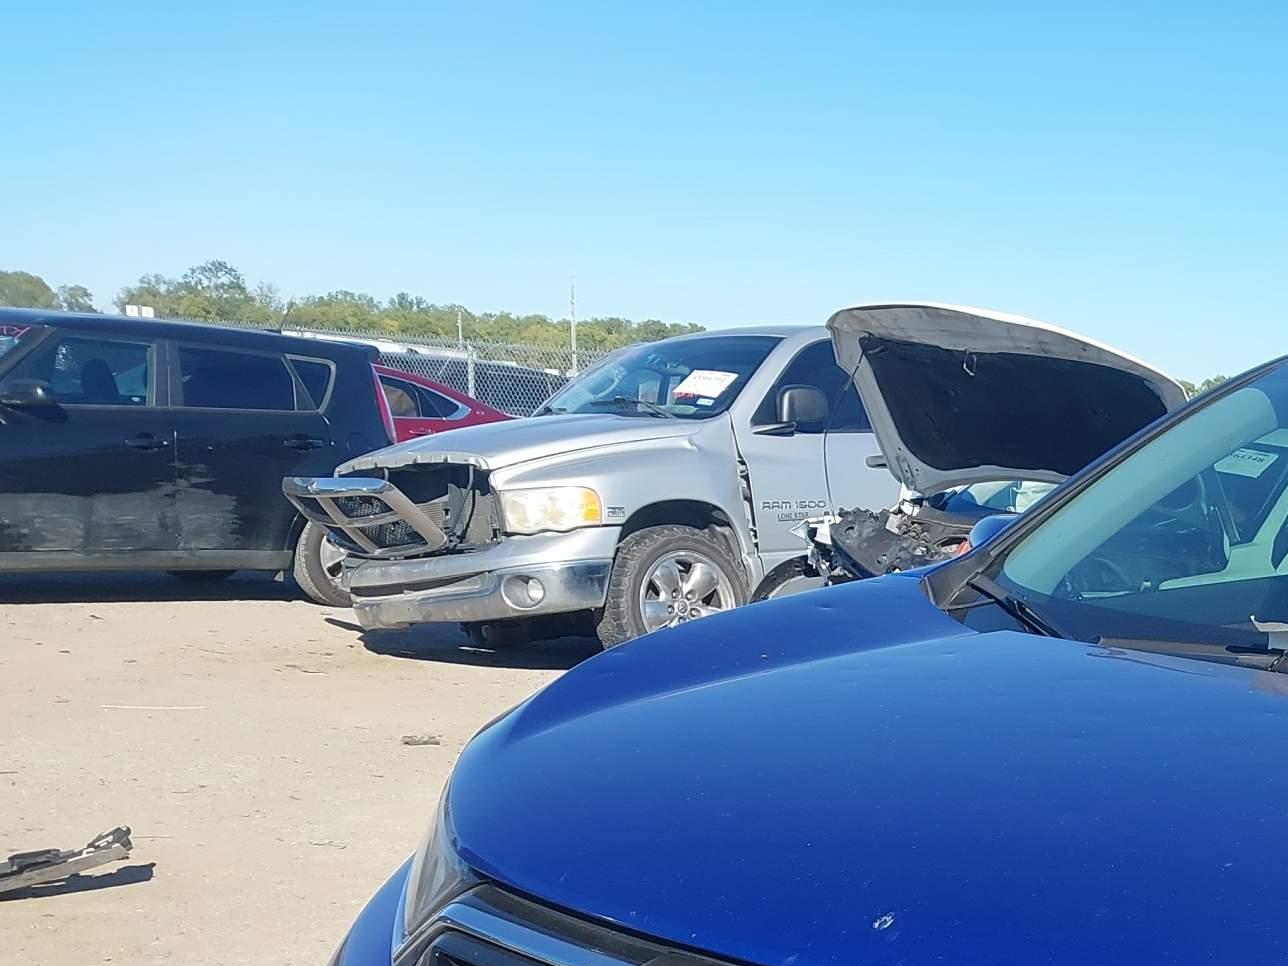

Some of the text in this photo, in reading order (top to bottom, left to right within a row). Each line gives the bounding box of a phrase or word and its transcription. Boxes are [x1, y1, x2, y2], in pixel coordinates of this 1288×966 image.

[762, 500, 827, 510] RAM 1500
[777, 512, 793, 520] LONE
